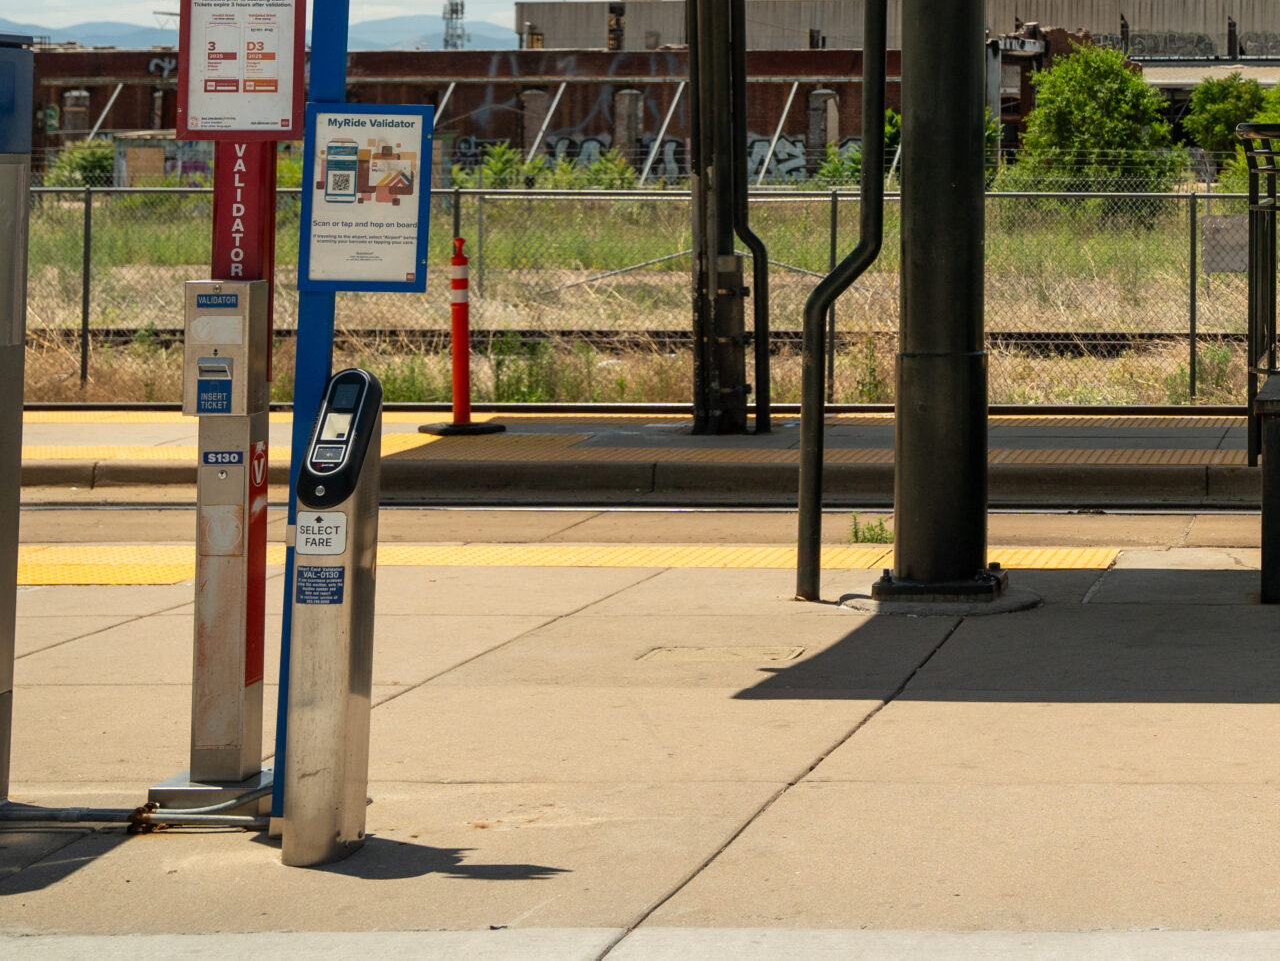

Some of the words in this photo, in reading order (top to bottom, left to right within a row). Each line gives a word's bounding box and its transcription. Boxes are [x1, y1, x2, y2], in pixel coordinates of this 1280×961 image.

[207, 41, 216, 51] 3
[246, 41, 265, 51] D3
[327, 118, 367, 129] MyRide
[369, 119, 416, 128] Validator
[230, 143, 247, 277] VALIDATOR
[370, 221, 384, 229] hop
[198, 296, 237, 304] VALIDATOR
[200, 392, 228, 400] INSERT
[200, 401, 228, 409] TICKET
[207, 453, 239, 463] S130
[254, 458, 265, 484] V
[299, 525, 341, 535] SELECT
[304, 537, 332, 547] FARE
